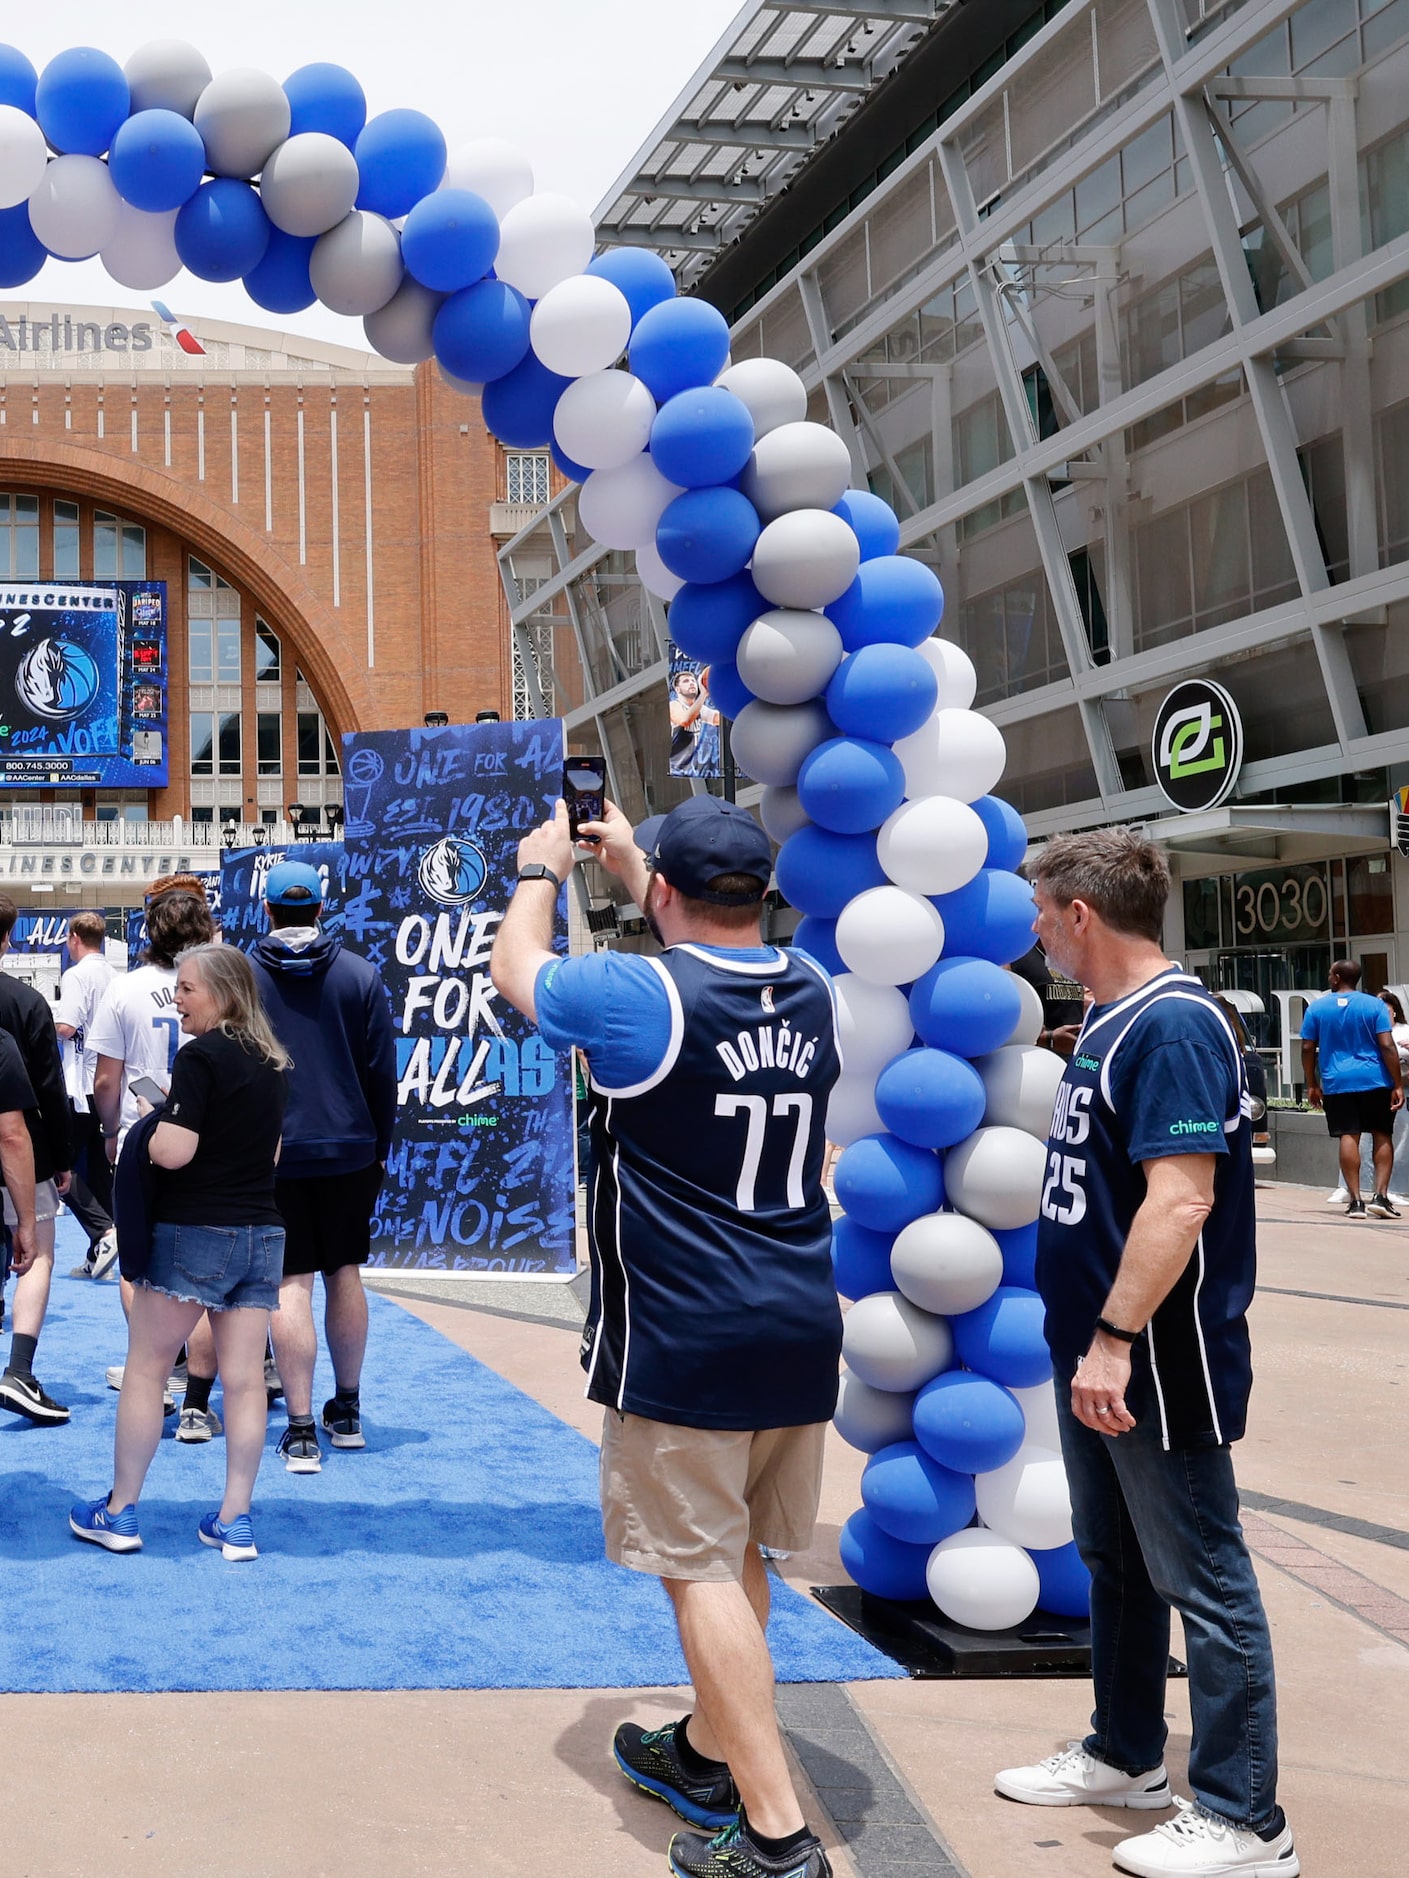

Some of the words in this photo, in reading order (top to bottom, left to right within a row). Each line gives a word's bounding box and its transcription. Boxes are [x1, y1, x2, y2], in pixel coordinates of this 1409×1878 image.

[10, 613, 31, 637] 2
[11, 726, 49, 746] 2024
[6, 762, 68, 770] 800.745.3000
[6, 774, 45, 782] @AACenter
[474, 752, 508, 776] FOR
[448, 793, 535, 834] 1980
[254, 852, 287, 871] KYRIE
[1236, 875, 1327, 934] 3030
[27, 916, 70, 946] ALL
[395, 903, 506, 973] ONE
[402, 972, 511, 1048] FOR
[715, 1019, 819, 1082] DONČIĆ
[1075, 1054, 1100, 1072] chime
[397, 1036, 503, 1108] ALL
[458, 1113, 498, 1126] chime
[1169, 1119, 1218, 1136] chime
[714, 1092, 813, 1211] 77
[1042, 1151, 1088, 1226] 25
[416, 1190, 576, 1250] NOISE
